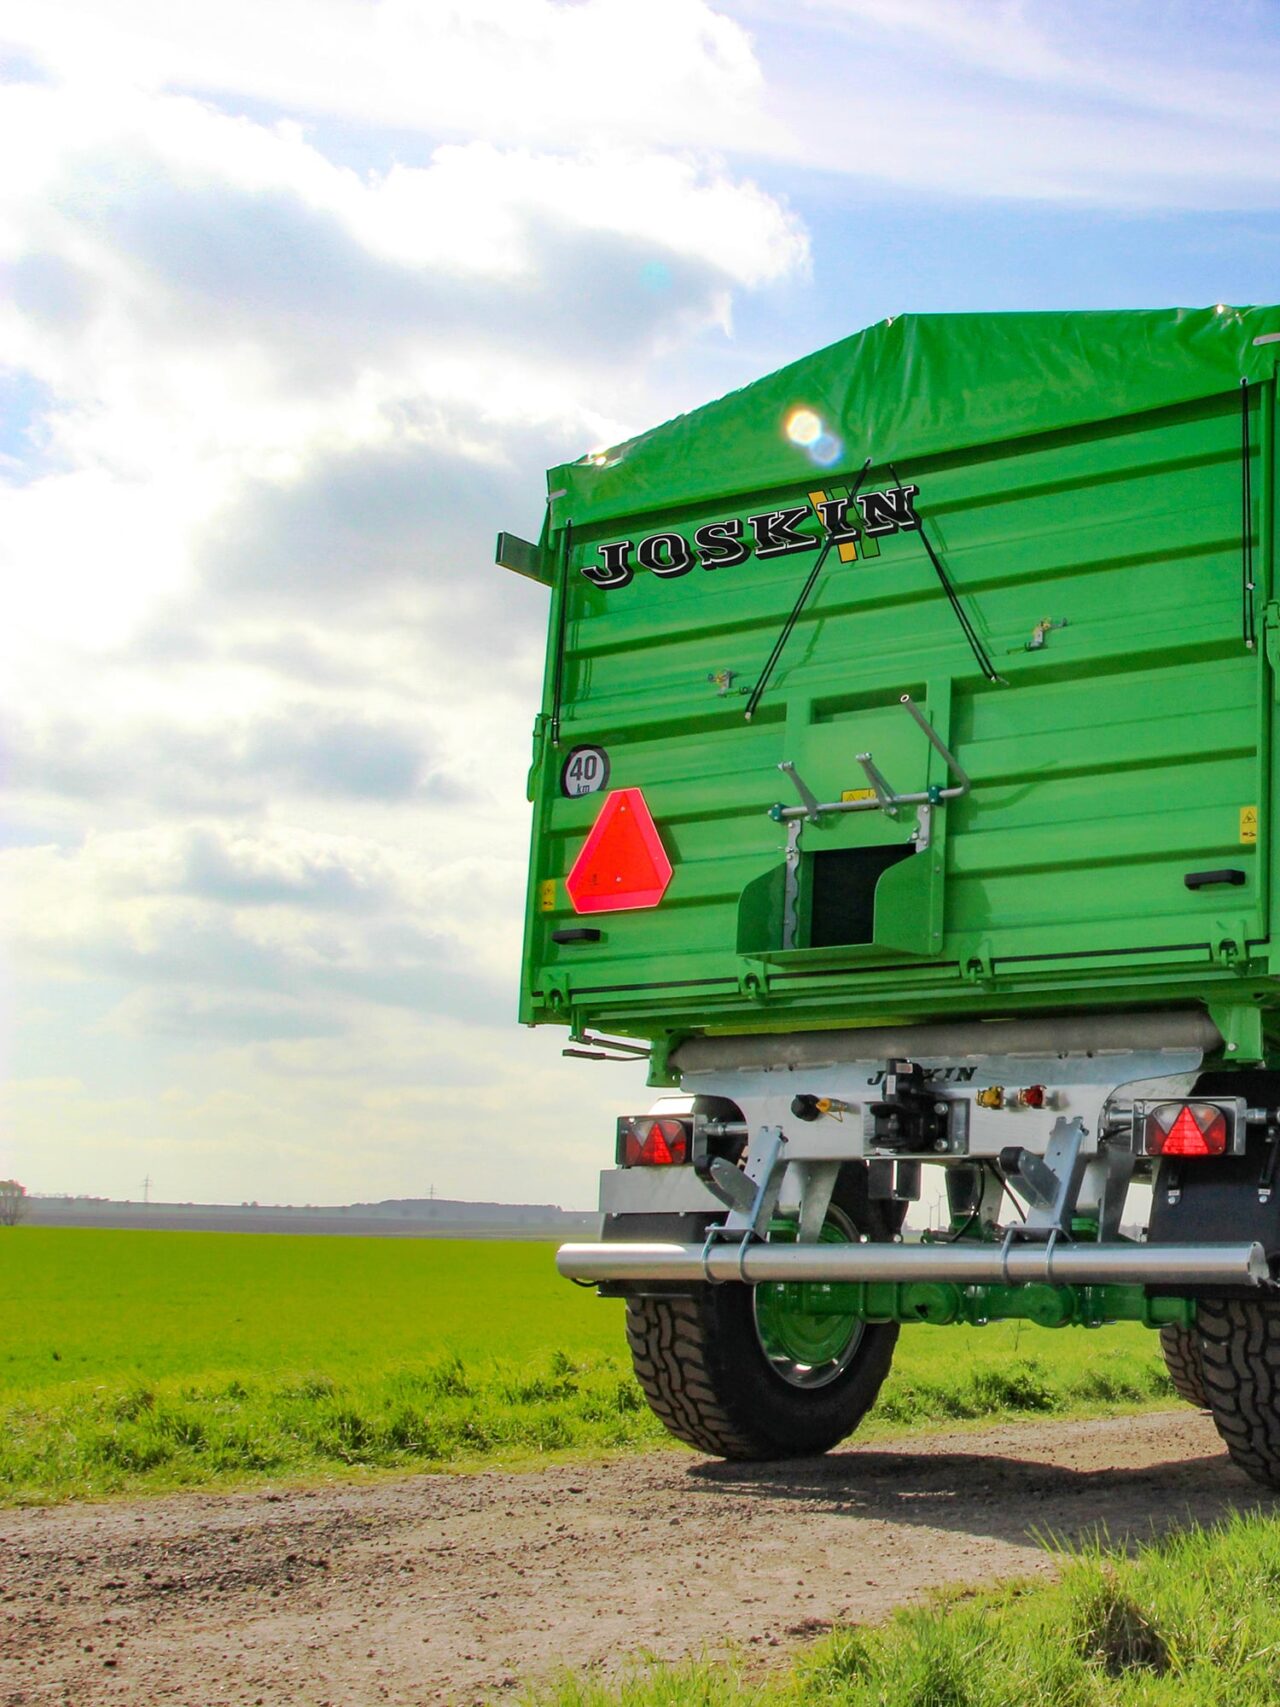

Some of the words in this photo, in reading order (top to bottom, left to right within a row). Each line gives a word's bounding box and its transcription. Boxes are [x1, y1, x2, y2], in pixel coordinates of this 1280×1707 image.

[581, 484, 919, 590] JOSKIN
[570, 755, 597, 781] 40
[577, 783, 590, 793] km
[867, 1066, 977, 1086] JKIN
